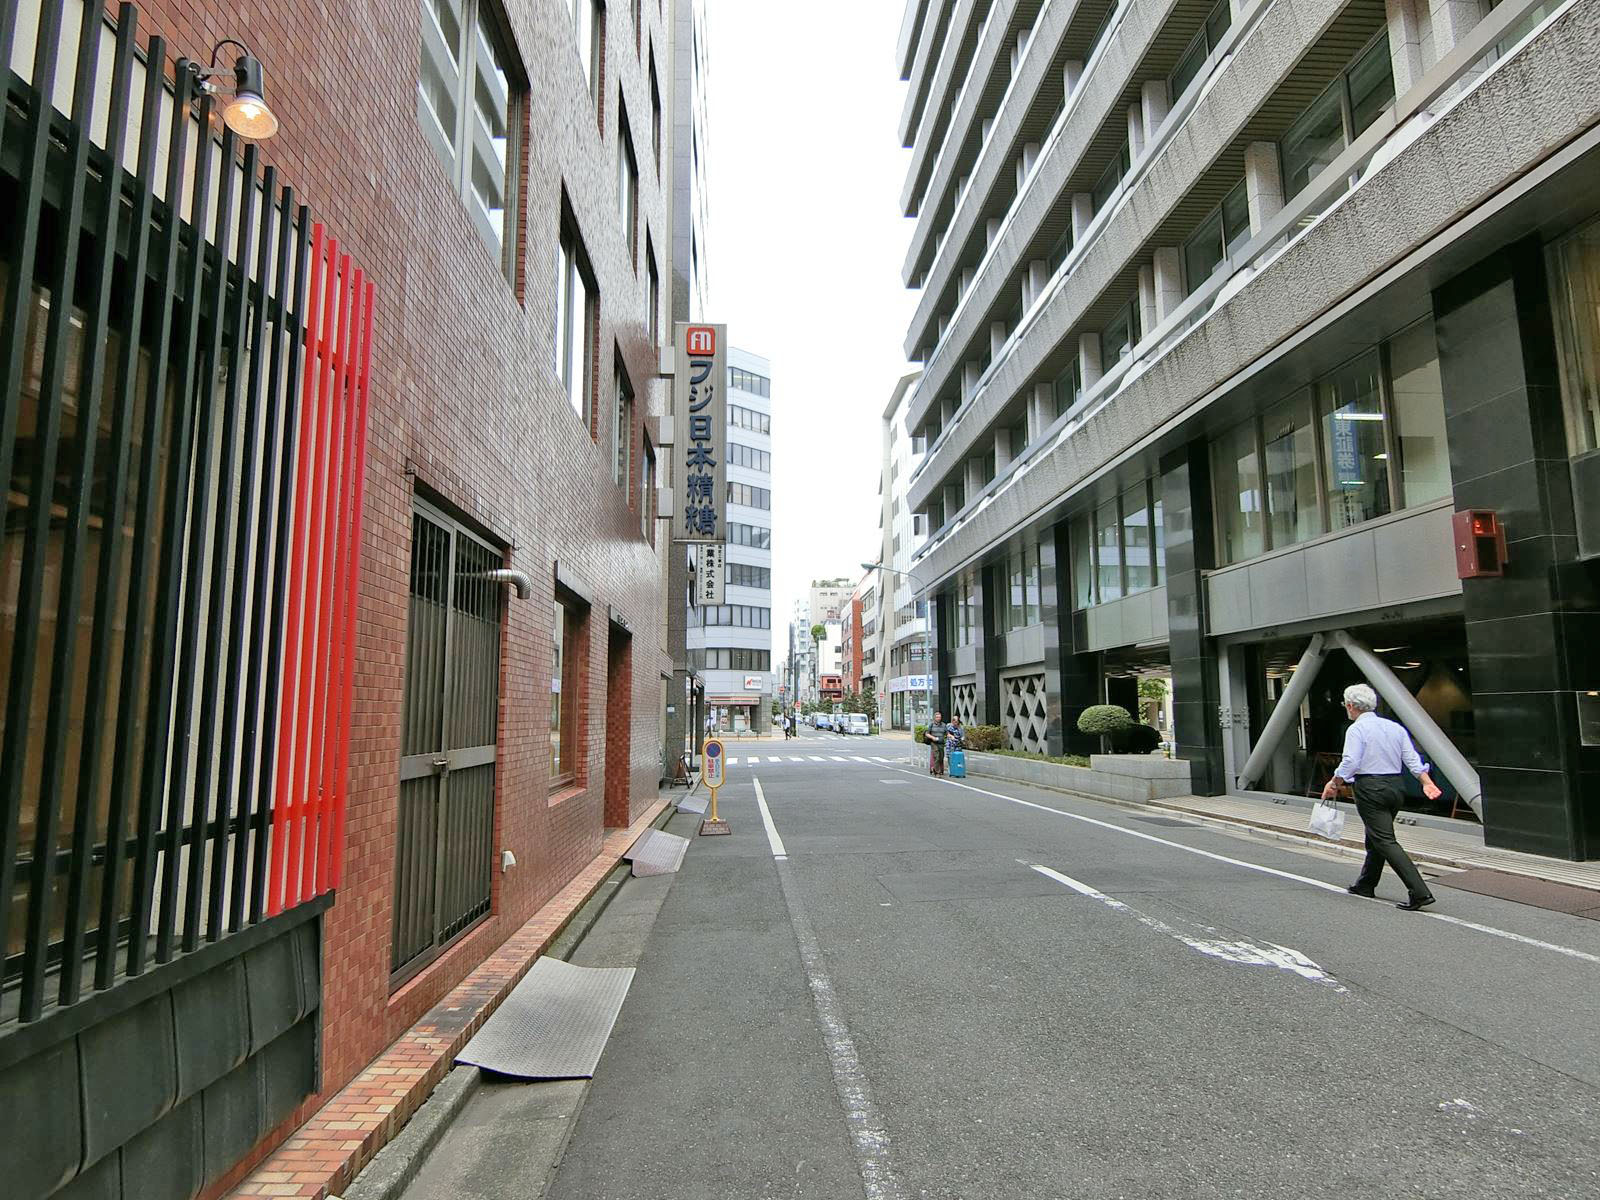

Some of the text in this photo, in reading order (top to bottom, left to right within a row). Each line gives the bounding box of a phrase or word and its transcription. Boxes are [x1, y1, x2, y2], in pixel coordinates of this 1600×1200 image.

[685, 360, 717, 536] フジ日本精糖
